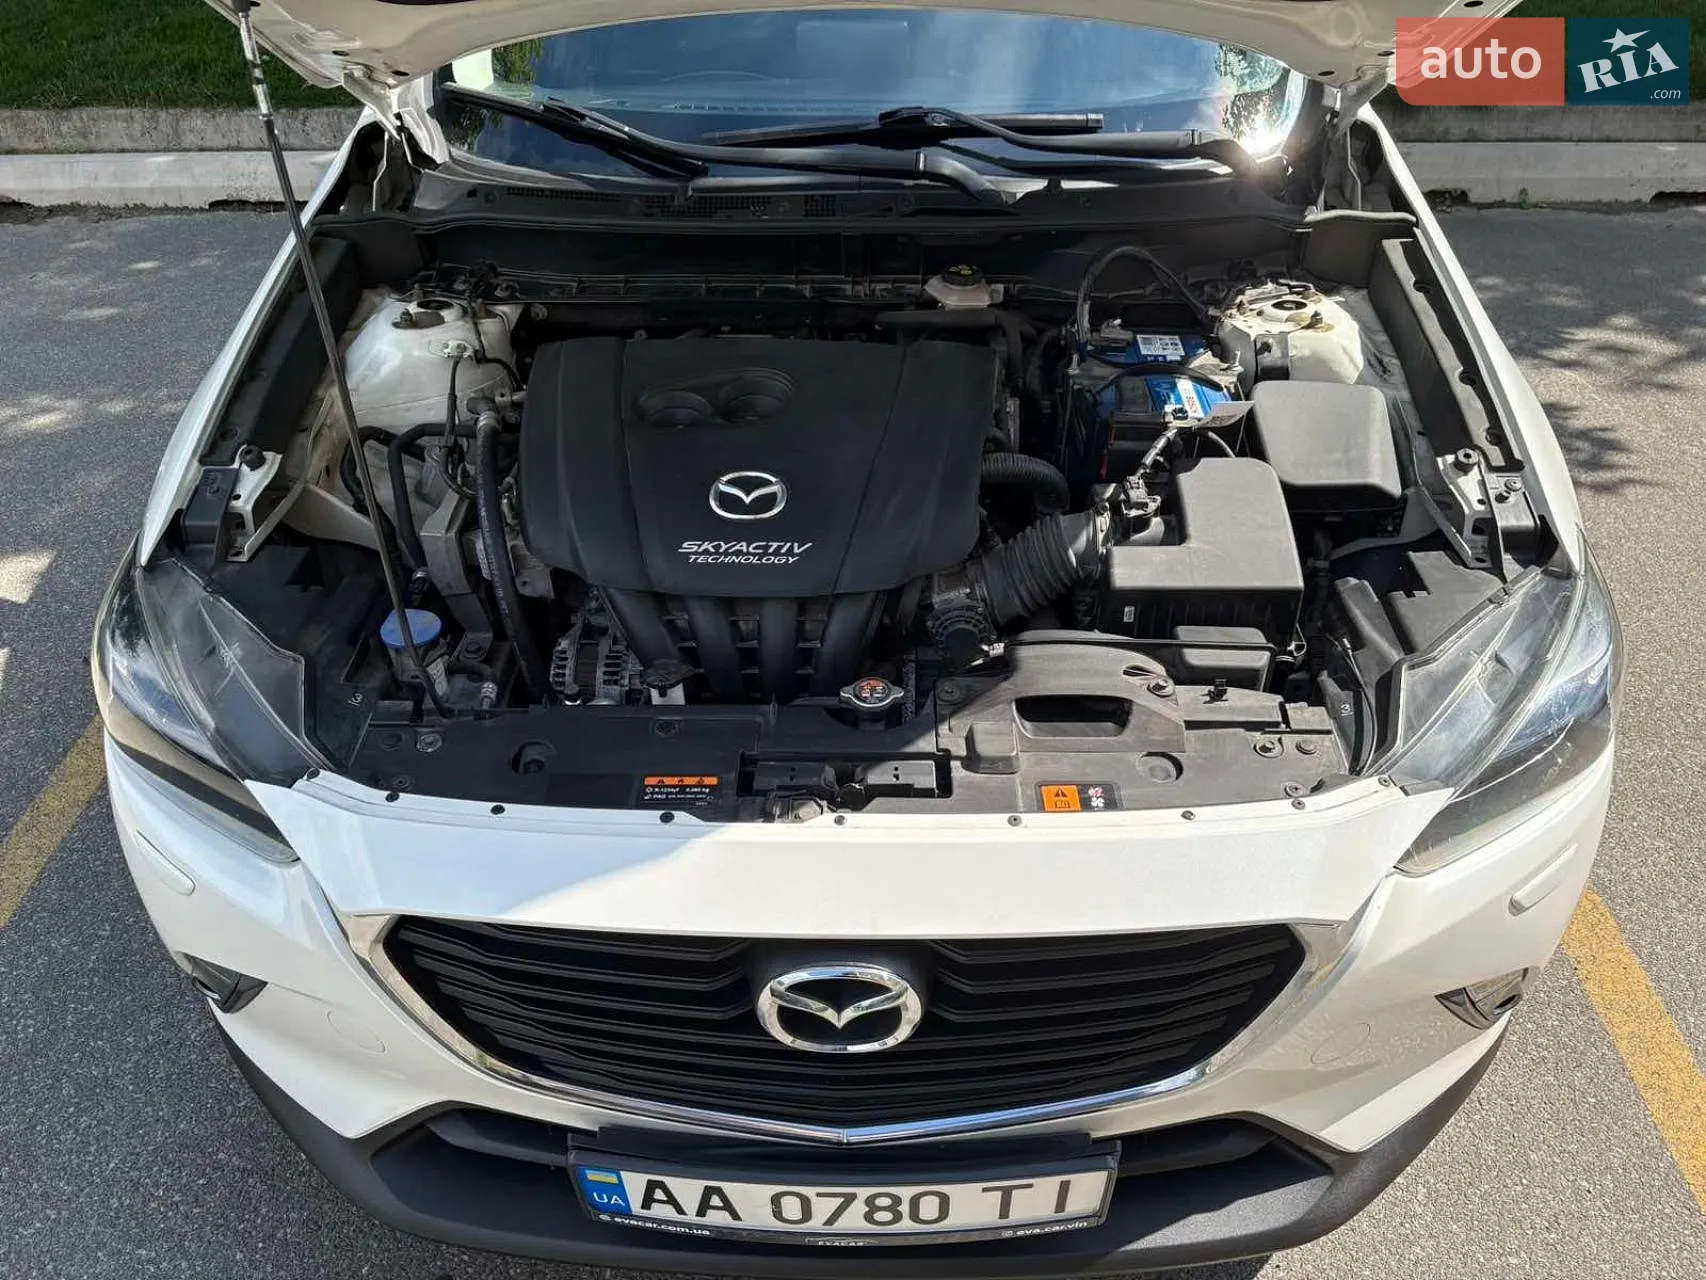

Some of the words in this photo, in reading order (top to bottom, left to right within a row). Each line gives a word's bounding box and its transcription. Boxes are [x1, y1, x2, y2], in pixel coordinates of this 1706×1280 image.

[677, 540, 813, 554] SKYACTIV
[688, 554, 800, 564] TECHNOLOGY
[592, 1191, 626, 1207] UA
[640, 1179, 743, 1222] AA
[770, 1190, 951, 1227] 0780
